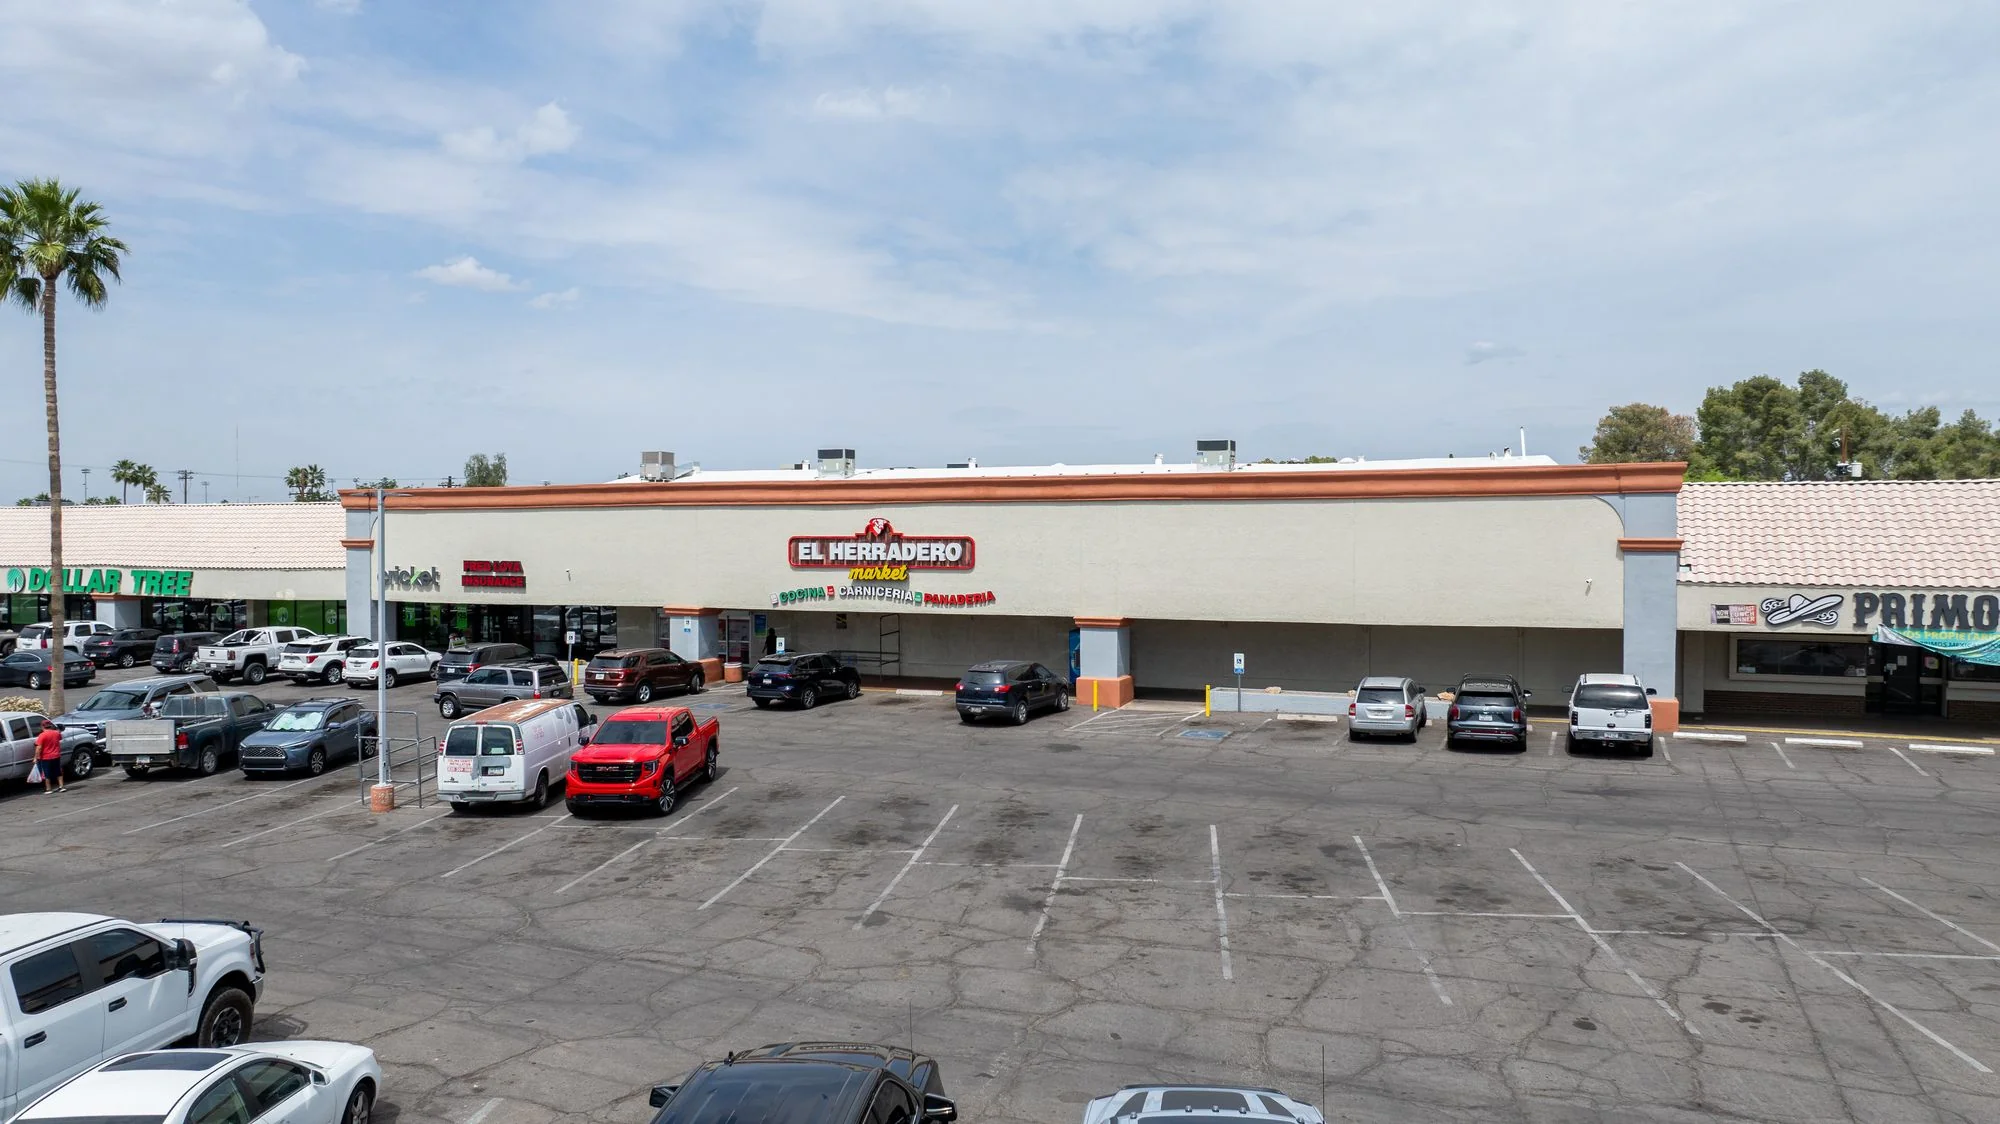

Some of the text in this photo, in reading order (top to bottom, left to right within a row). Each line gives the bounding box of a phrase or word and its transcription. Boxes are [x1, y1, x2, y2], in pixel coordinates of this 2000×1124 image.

[799, 542, 962, 562] EL HERRADERO
[463, 560, 523, 573] FRED LOYA
[848, 565, 908, 581] market
[130, 569, 193, 596] TREE
[462, 574, 526, 588] INSURANCE
[779, 586, 996, 605] COCINA CARNICERIA PANADERIA
